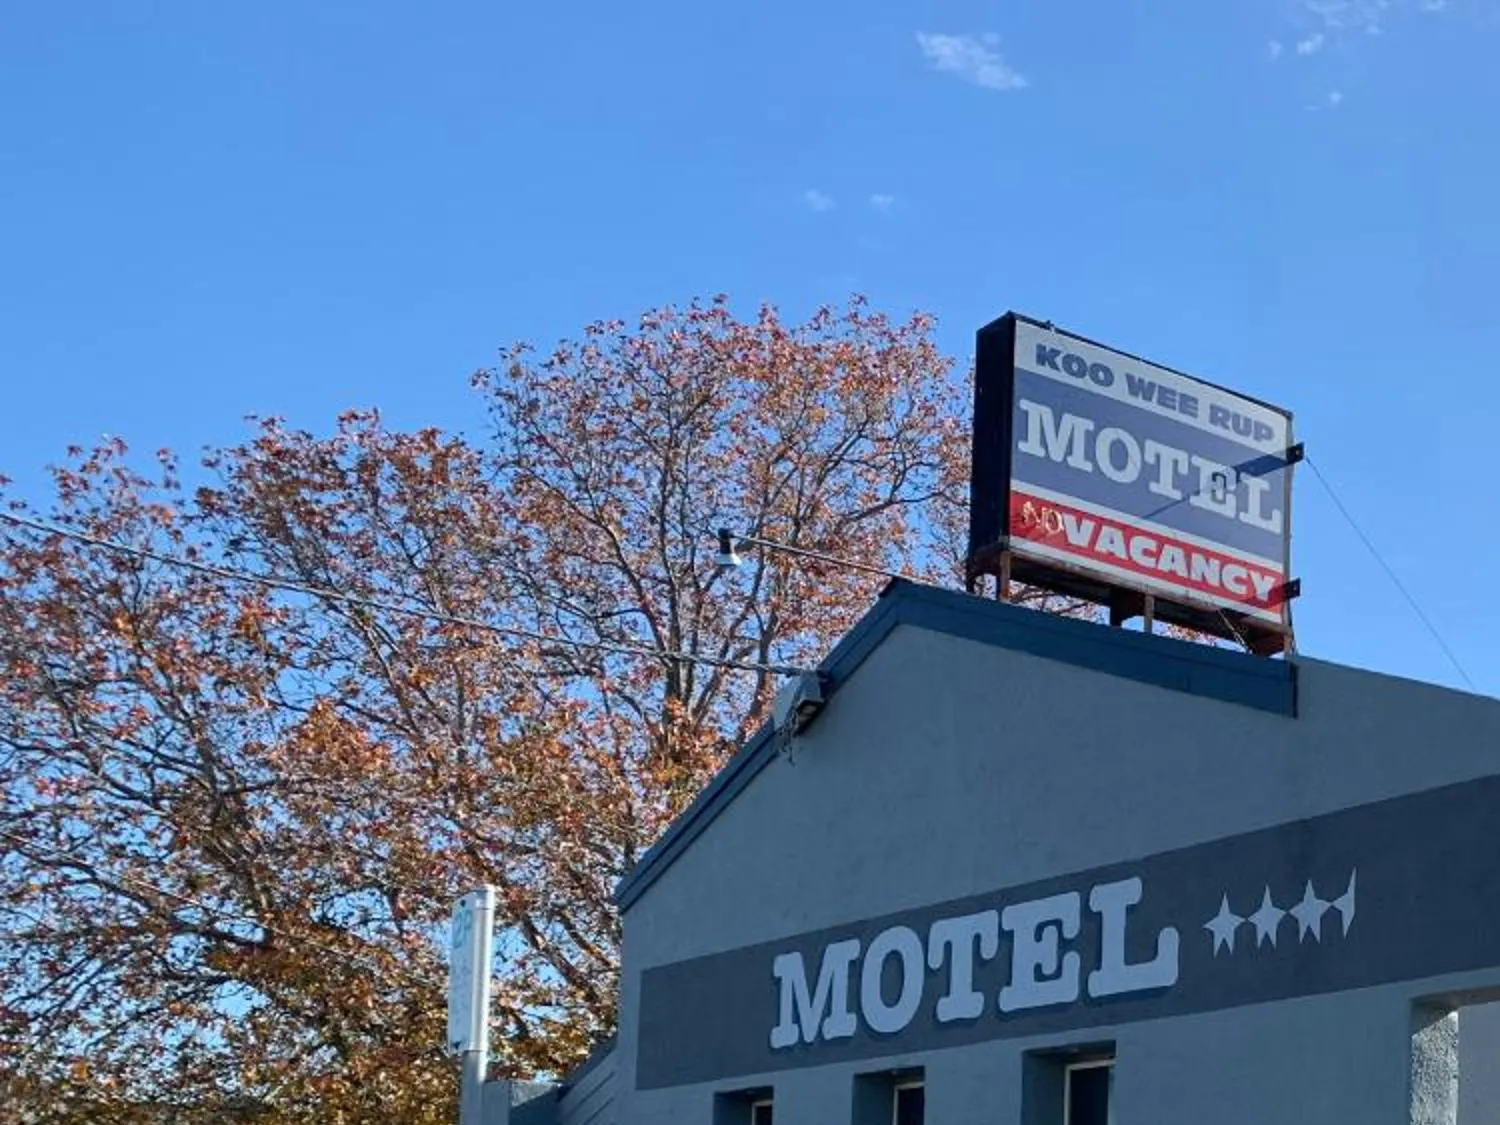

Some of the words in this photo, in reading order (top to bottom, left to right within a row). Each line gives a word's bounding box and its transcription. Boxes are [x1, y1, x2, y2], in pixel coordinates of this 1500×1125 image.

[1036, 344, 1114, 387] KOO
[1126, 373, 1200, 417] WEE
[1209, 403, 1274, 443] RUP
[1018, 399, 1281, 534] MOTEL
[1063, 513, 1277, 599] VACANCY
[770, 876, 1180, 1049] MOTEL
